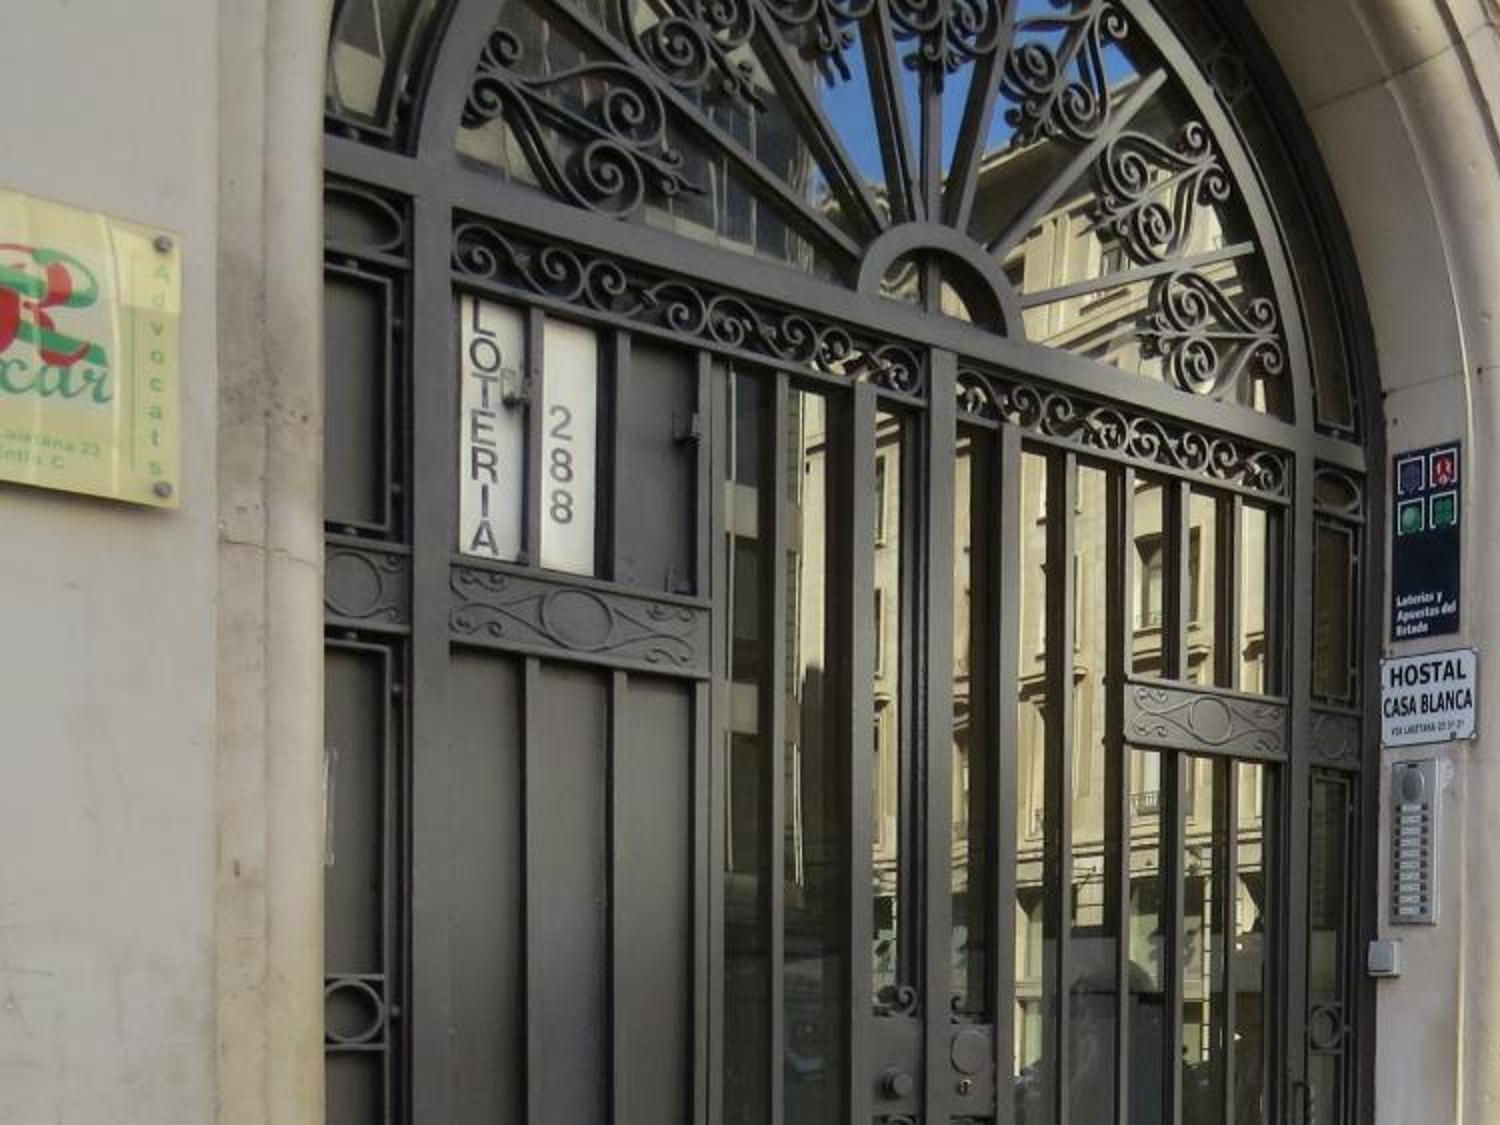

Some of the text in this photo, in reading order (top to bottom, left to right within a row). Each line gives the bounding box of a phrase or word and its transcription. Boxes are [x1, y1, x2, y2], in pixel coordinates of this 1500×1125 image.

[469, 299, 500, 556] LOTERIA
[549, 404, 574, 525] 288
[1383, 687, 1473, 719] CASA BLANCA
[1390, 657, 1467, 688] HOSTAL
